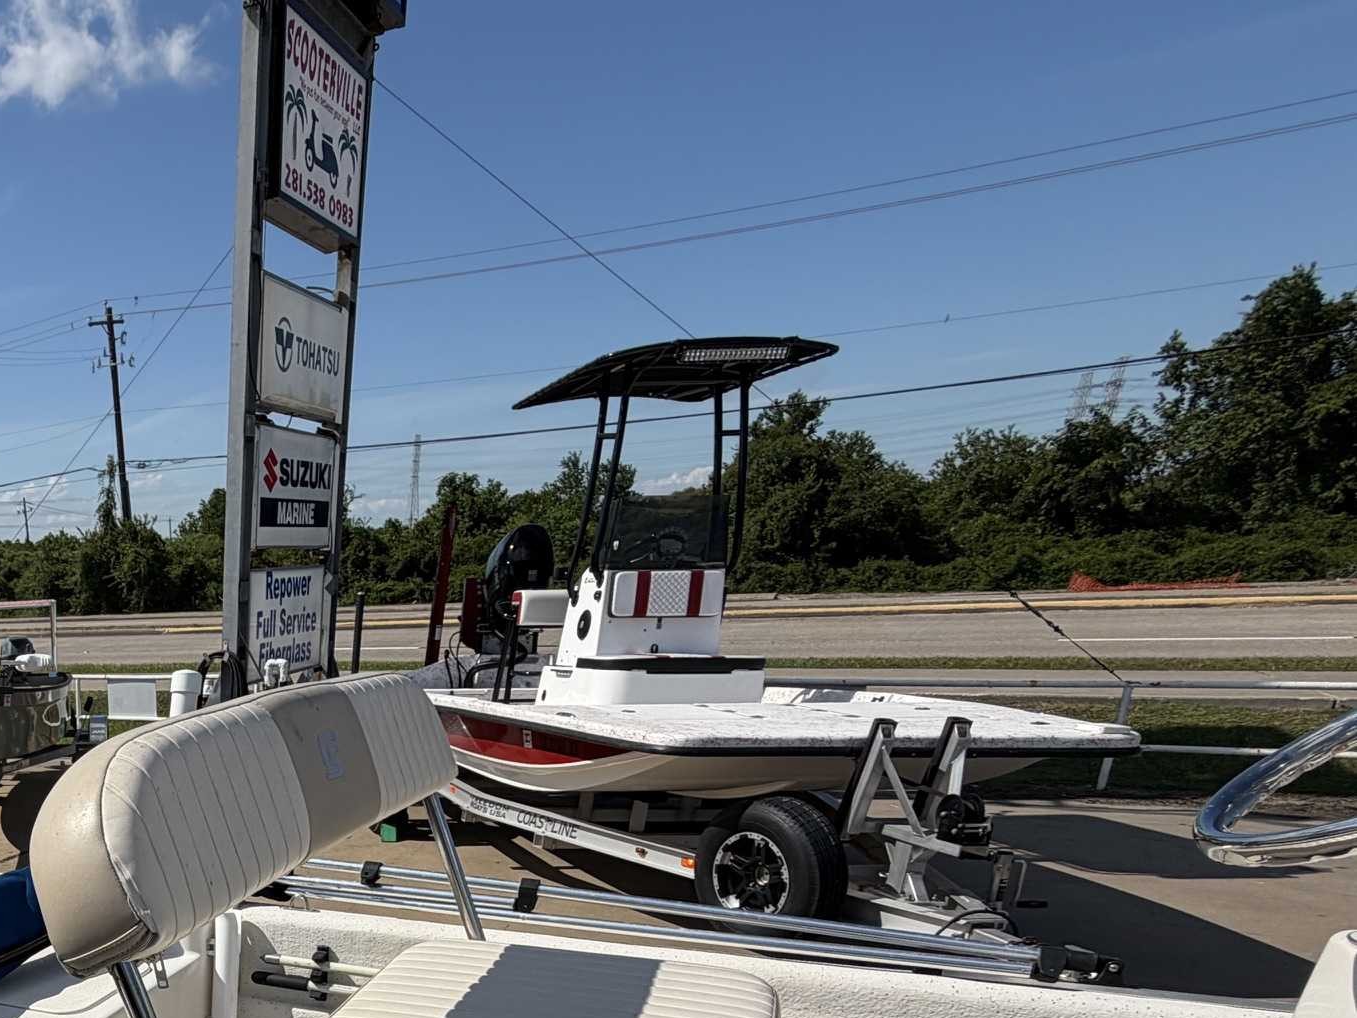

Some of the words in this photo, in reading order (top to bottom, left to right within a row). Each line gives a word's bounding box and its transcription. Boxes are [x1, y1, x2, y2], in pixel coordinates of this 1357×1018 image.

[287, 19, 363, 121] SCOOTERVILLE
[285, 163, 326, 210] 281.538
[329, 195, 354, 228] 0983
[296, 336, 340, 377] TOHATSU
[279, 457, 332, 490] SUZUKI
[277, 501, 316, 525] MARINE
[266, 570, 312, 605] Repower
[256, 610, 276, 640] Full
[279, 606, 317, 636] Service
